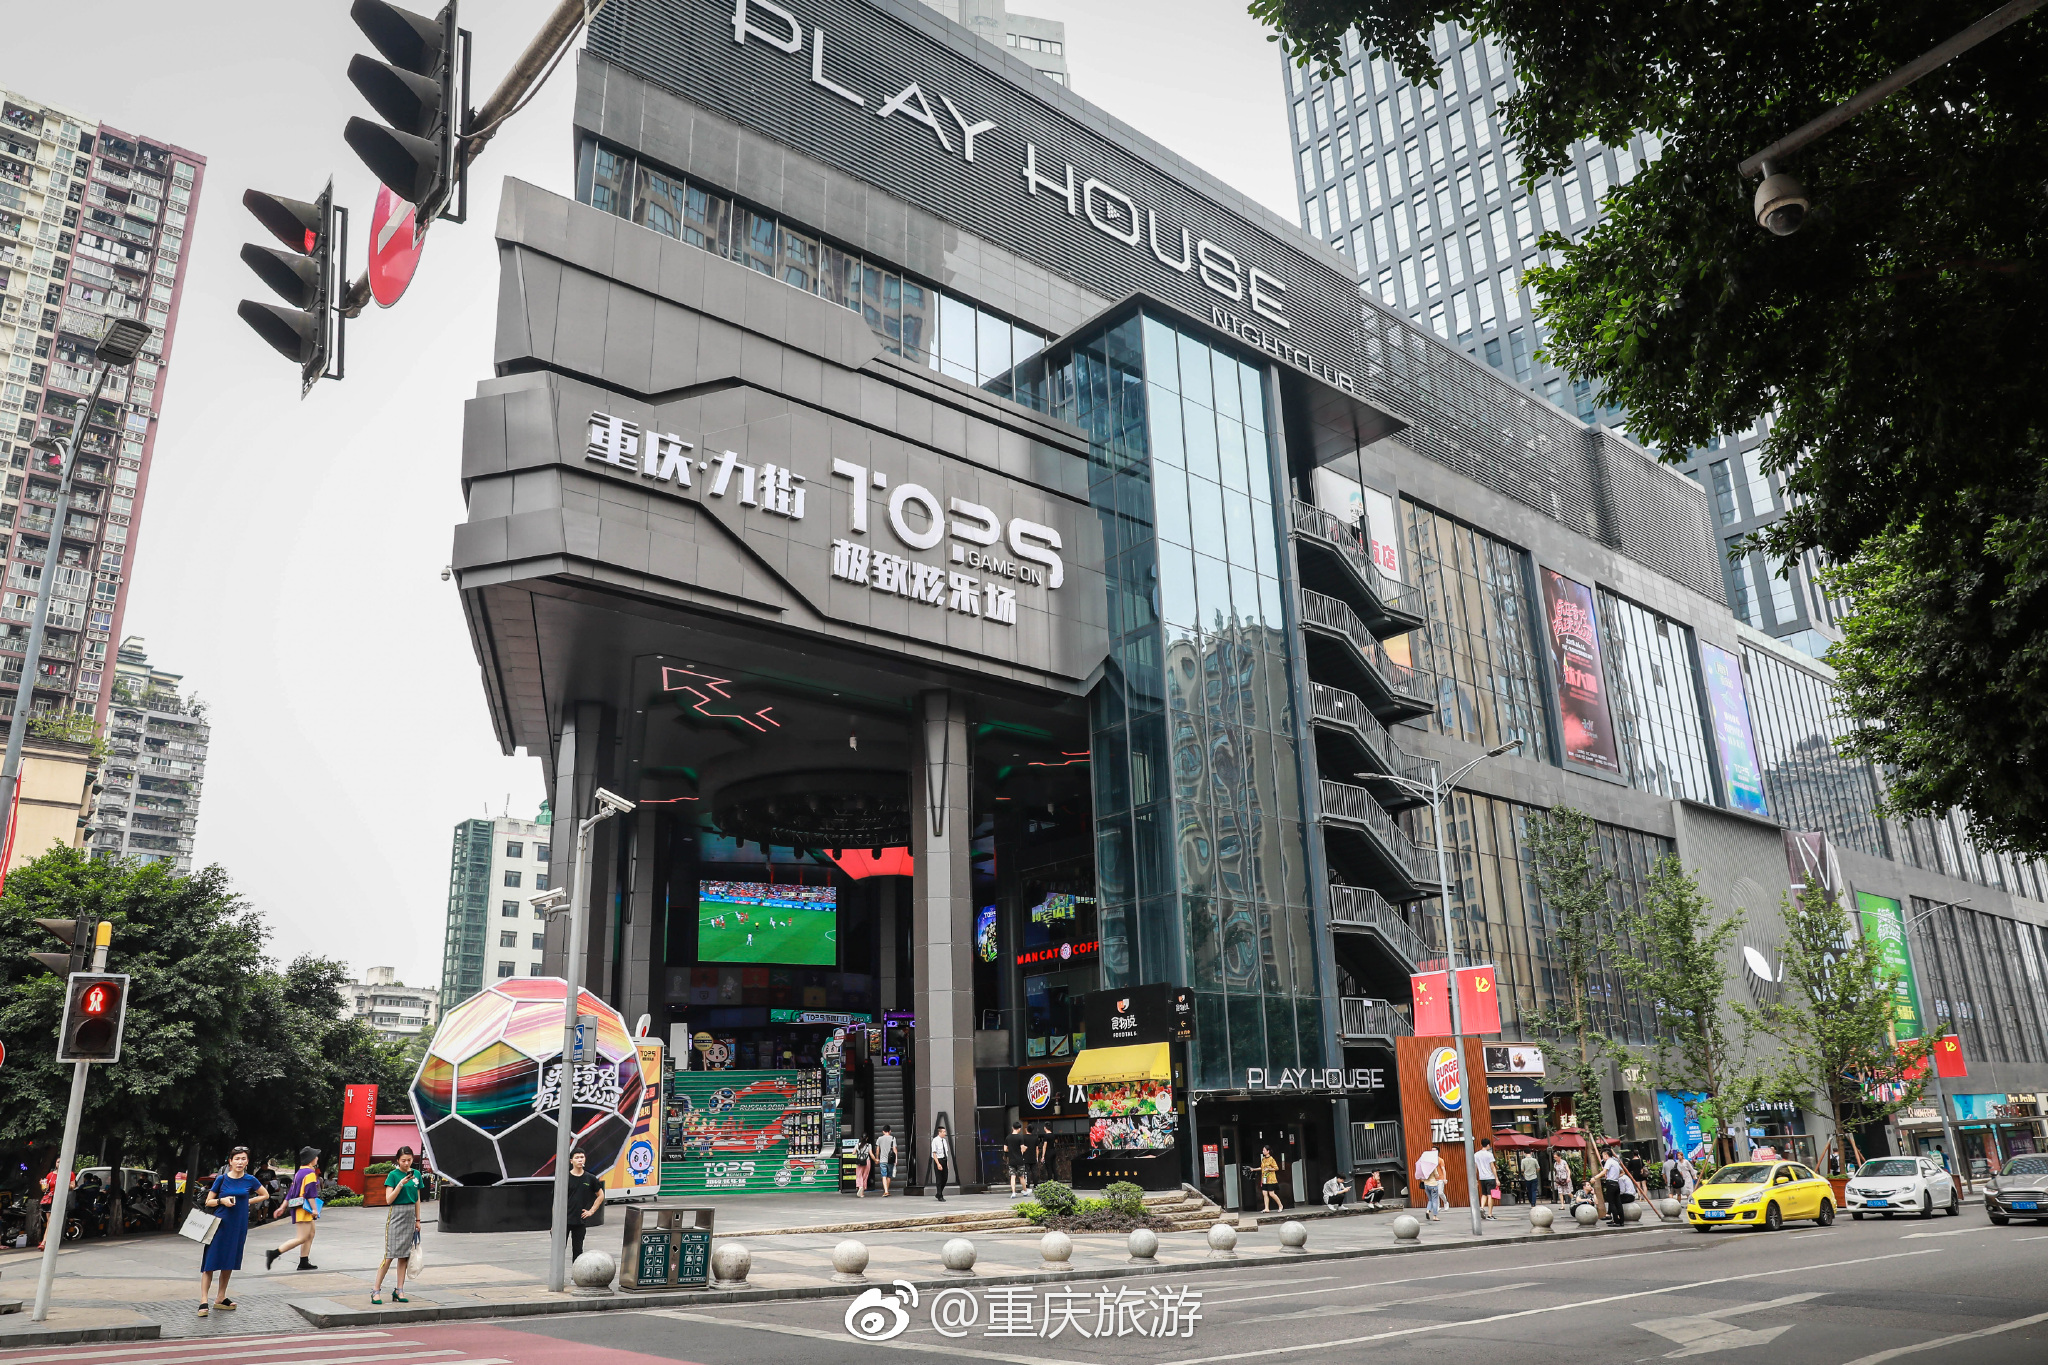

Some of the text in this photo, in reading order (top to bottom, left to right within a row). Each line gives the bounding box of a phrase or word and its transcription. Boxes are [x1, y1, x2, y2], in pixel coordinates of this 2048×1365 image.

[732, 0, 1290, 329] PLAY HOUSE
[584, 410, 806, 520] 重庆·九街
[830, 456, 1065, 589] TOPS
[829, 537, 1017, 625] 极致炫乐场
[967, 550, 1042, 585] GAME ON
[1031, 1085, 1049, 1102] KING
[1247, 1067, 1385, 1089] PLAY HOUSE
